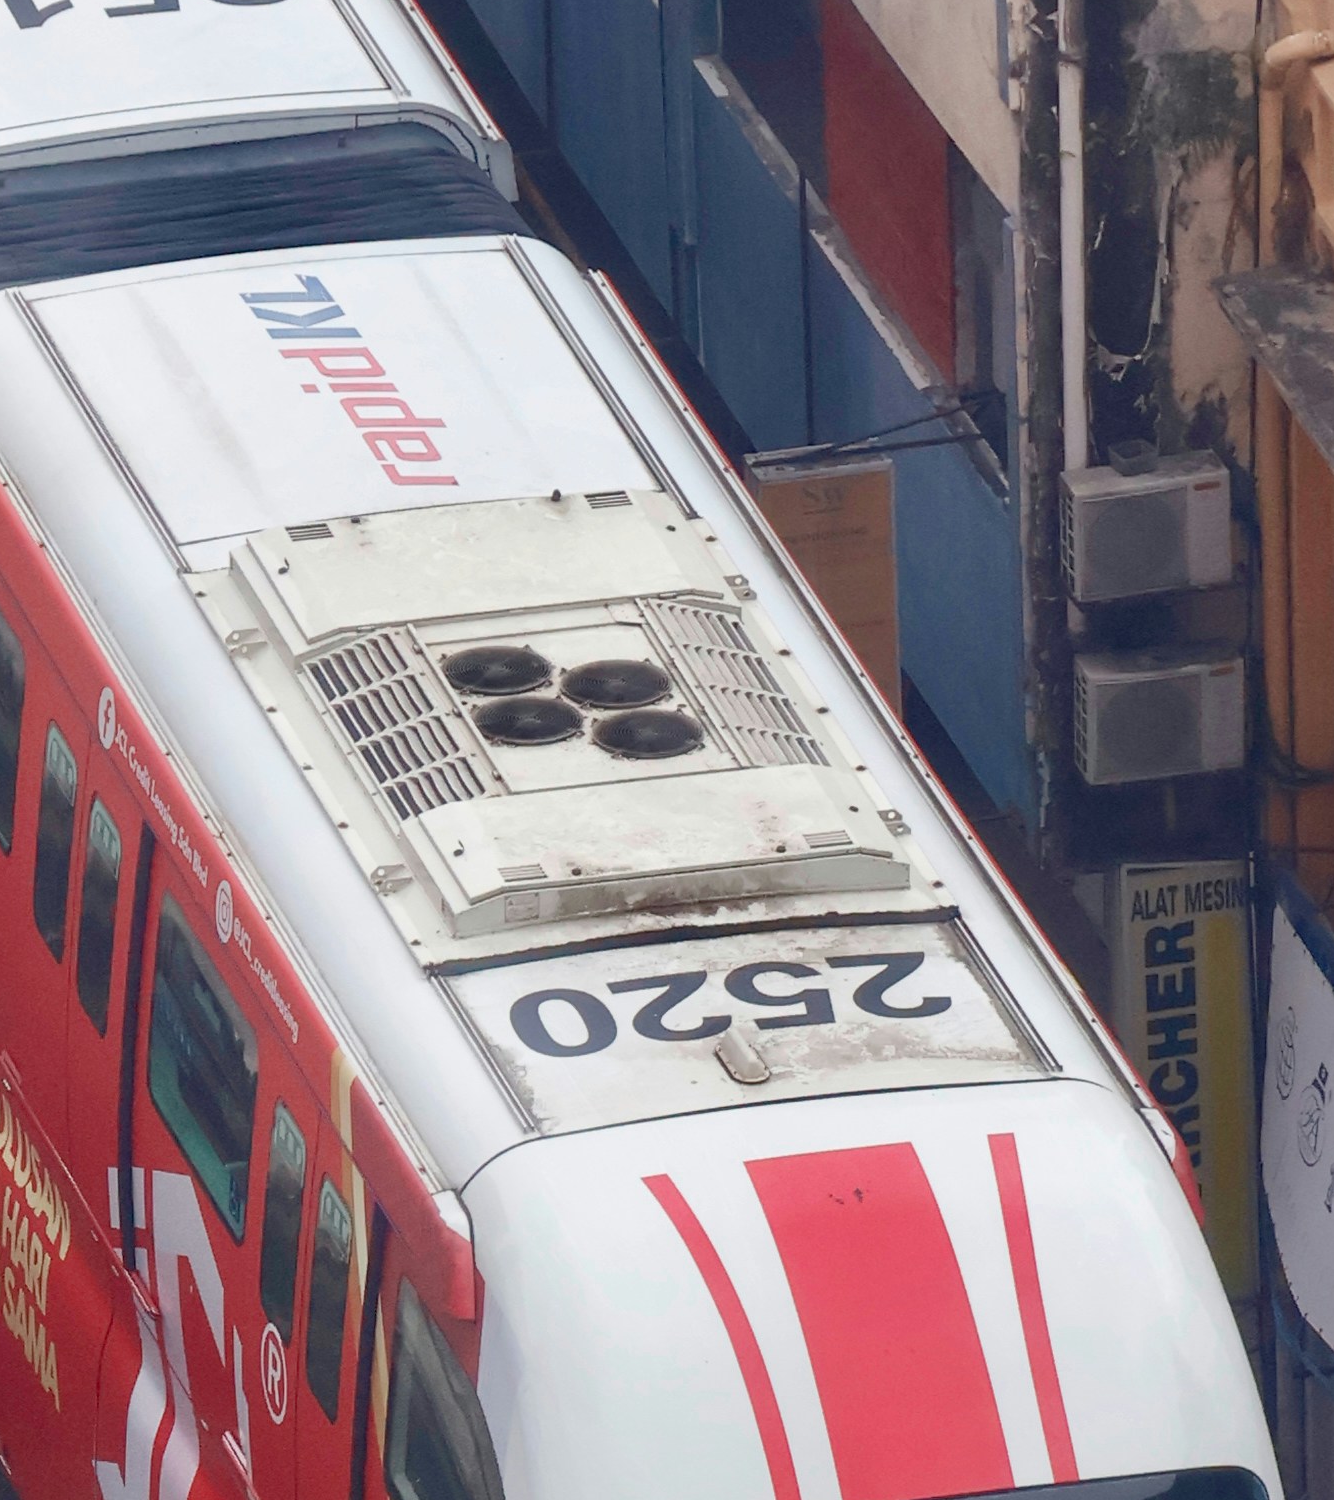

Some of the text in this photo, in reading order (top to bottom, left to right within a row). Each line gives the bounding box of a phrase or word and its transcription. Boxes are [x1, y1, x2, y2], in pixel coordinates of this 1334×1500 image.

[239, 273, 460, 486] rapidKL
[128, 746, 151, 798] Credit
[150, 779, 178, 846] Leasing
[1131, 885, 1178, 922] ALAT
[510, 951, 953, 1058] 2520
[2, 1186, 51, 1316] HARI
[3, 1267, 61, 1413] SAMA
